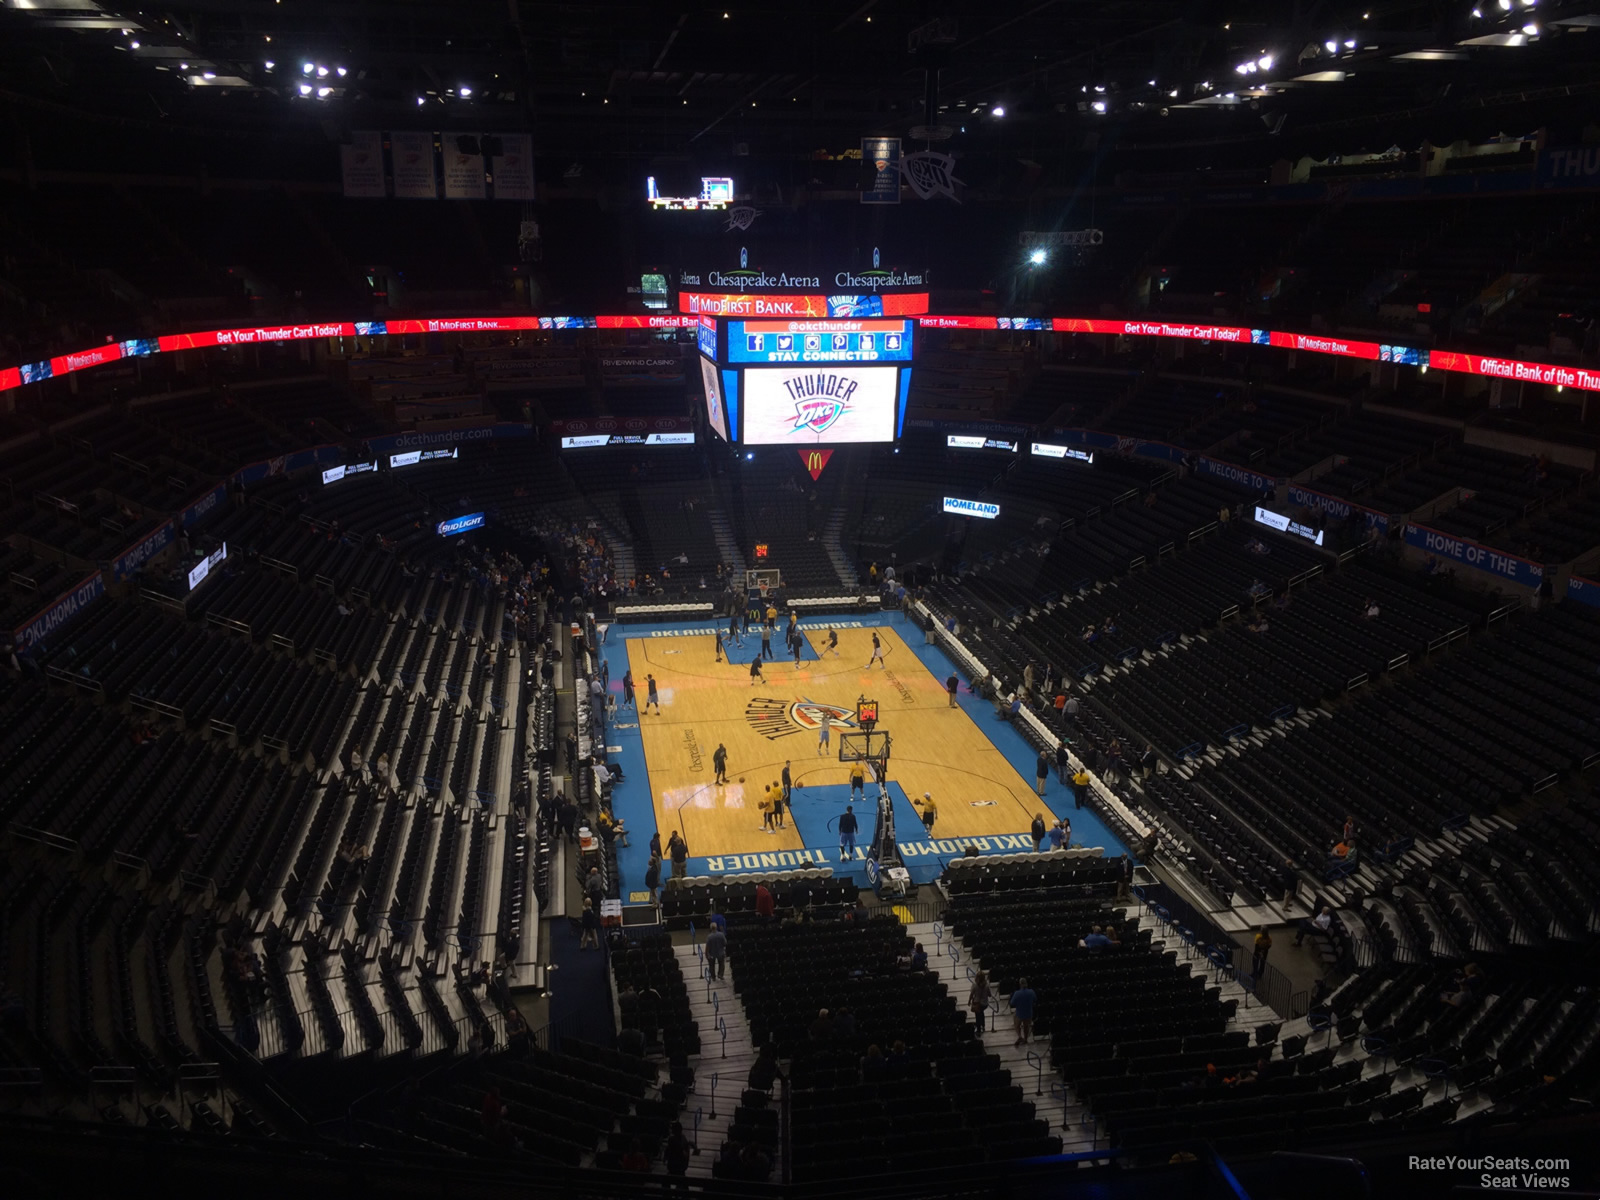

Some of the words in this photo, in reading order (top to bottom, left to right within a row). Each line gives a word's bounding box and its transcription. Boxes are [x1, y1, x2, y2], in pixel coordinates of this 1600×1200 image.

[708, 271, 777, 292] Chesapeake
[777, 272, 820, 287] Arena
[835, 271, 901, 292] Chesapeake
[902, 272, 922, 286] Arena
[755, 300, 794, 314] BANK
[477, 321, 498, 329] BANK
[649, 315, 681, 326] Official
[682, 316, 699, 326] Ban
[788, 322, 862, 332] @okcthunder
[920, 318, 938, 326] FIRST
[939, 318, 959, 327] BANK
[217, 332, 232, 343] Get
[233, 330, 254, 342] Your
[256, 328, 292, 341] Thunder
[293, 327, 313, 338] Card
[314, 325, 342, 336] Today!
[1124, 323, 1140, 334] Get
[1141, 323, 1161, 335] Your
[1161, 324, 1192, 337] Thunder
[1193, 326, 1212, 338] Card
[1213, 328, 1240, 341] Today!
[768, 352, 800, 361] STAY
[803, 351, 878, 361] CONNECTED
[1480, 359, 1514, 376] Official
[1516, 366, 1542, 380] Bank
[1544, 369, 1556, 382] of
[1556, 369, 1575, 385] the
[783, 374, 859, 401] THUNDER
[570, 422, 584, 430] KIA
[600, 421, 613, 429] KIA
[629, 420, 643, 429] KIA
[659, 420, 673, 428] KIA
[396, 428, 493, 448] okcthunder.com
[1209, 462, 1249, 485] WELCOME
[1251, 474, 1263, 489] TO
[945, 499, 997, 514] HOMELAND
[442, 523, 459, 533] BUD
[460, 516, 483, 529] LIGHT
[124, 543, 145, 571] HOME
[144, 537, 154, 555] OF
[154, 529, 166, 548] THE
[1426, 532, 1463, 558] HOME
[1466, 546, 1485, 564] OF
[1489, 553, 1517, 576] THE
[1530, 565, 1543, 577] 106
[1569, 578, 1583, 590] 107
[78, 580, 96, 606] CITY
[797, 621, 864, 631] HUNDER
[706, 849, 830, 872] THUNDER
